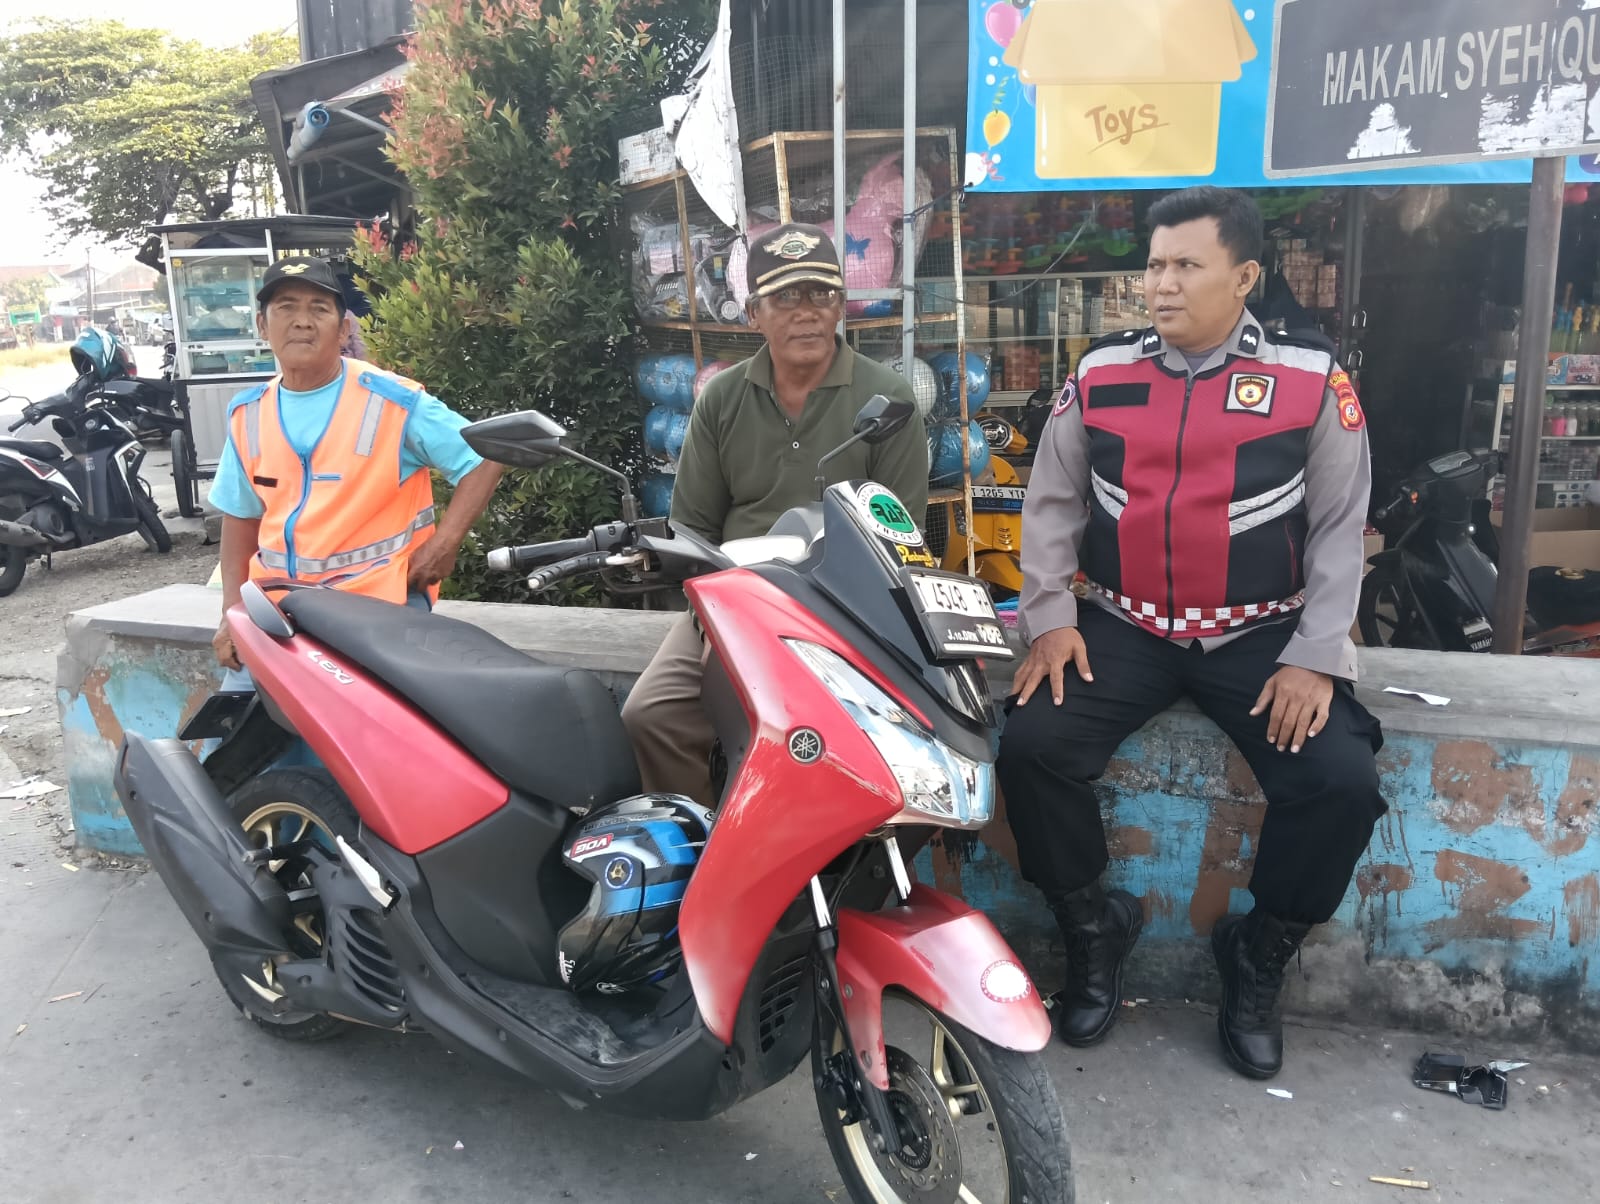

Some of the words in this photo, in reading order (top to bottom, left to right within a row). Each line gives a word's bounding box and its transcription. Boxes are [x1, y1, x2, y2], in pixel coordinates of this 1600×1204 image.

[1322, 36, 1446, 106] MAKAM
[1454, 21, 1548, 91] SYEH
[307, 650, 355, 685] LEXI
